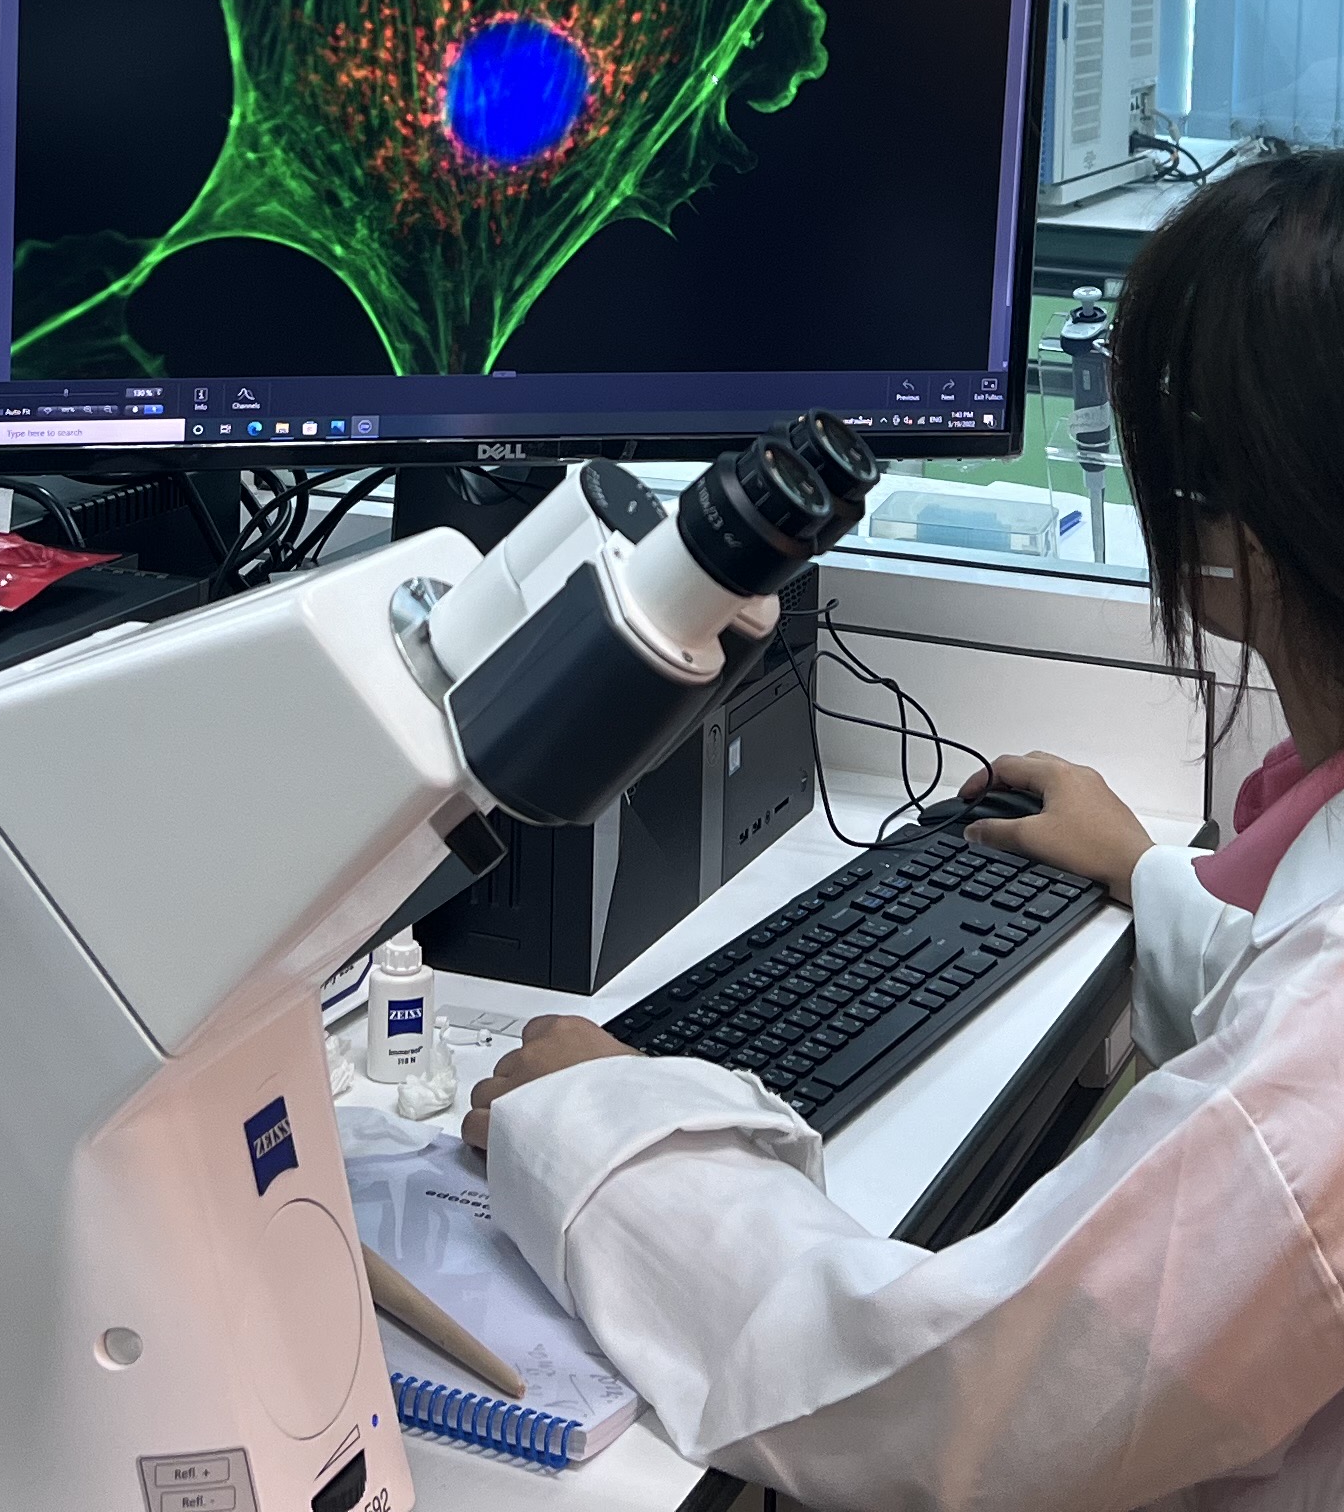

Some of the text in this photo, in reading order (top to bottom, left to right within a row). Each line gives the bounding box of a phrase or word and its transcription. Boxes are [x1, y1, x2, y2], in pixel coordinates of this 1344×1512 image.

[232, 402, 261, 410] Channels
[7, 428, 83, 438] Type here to search
[477, 443, 526, 460] DELL
[389, 1007, 423, 1020] ZEISS
[253, 1117, 292, 1159] ZEISS
